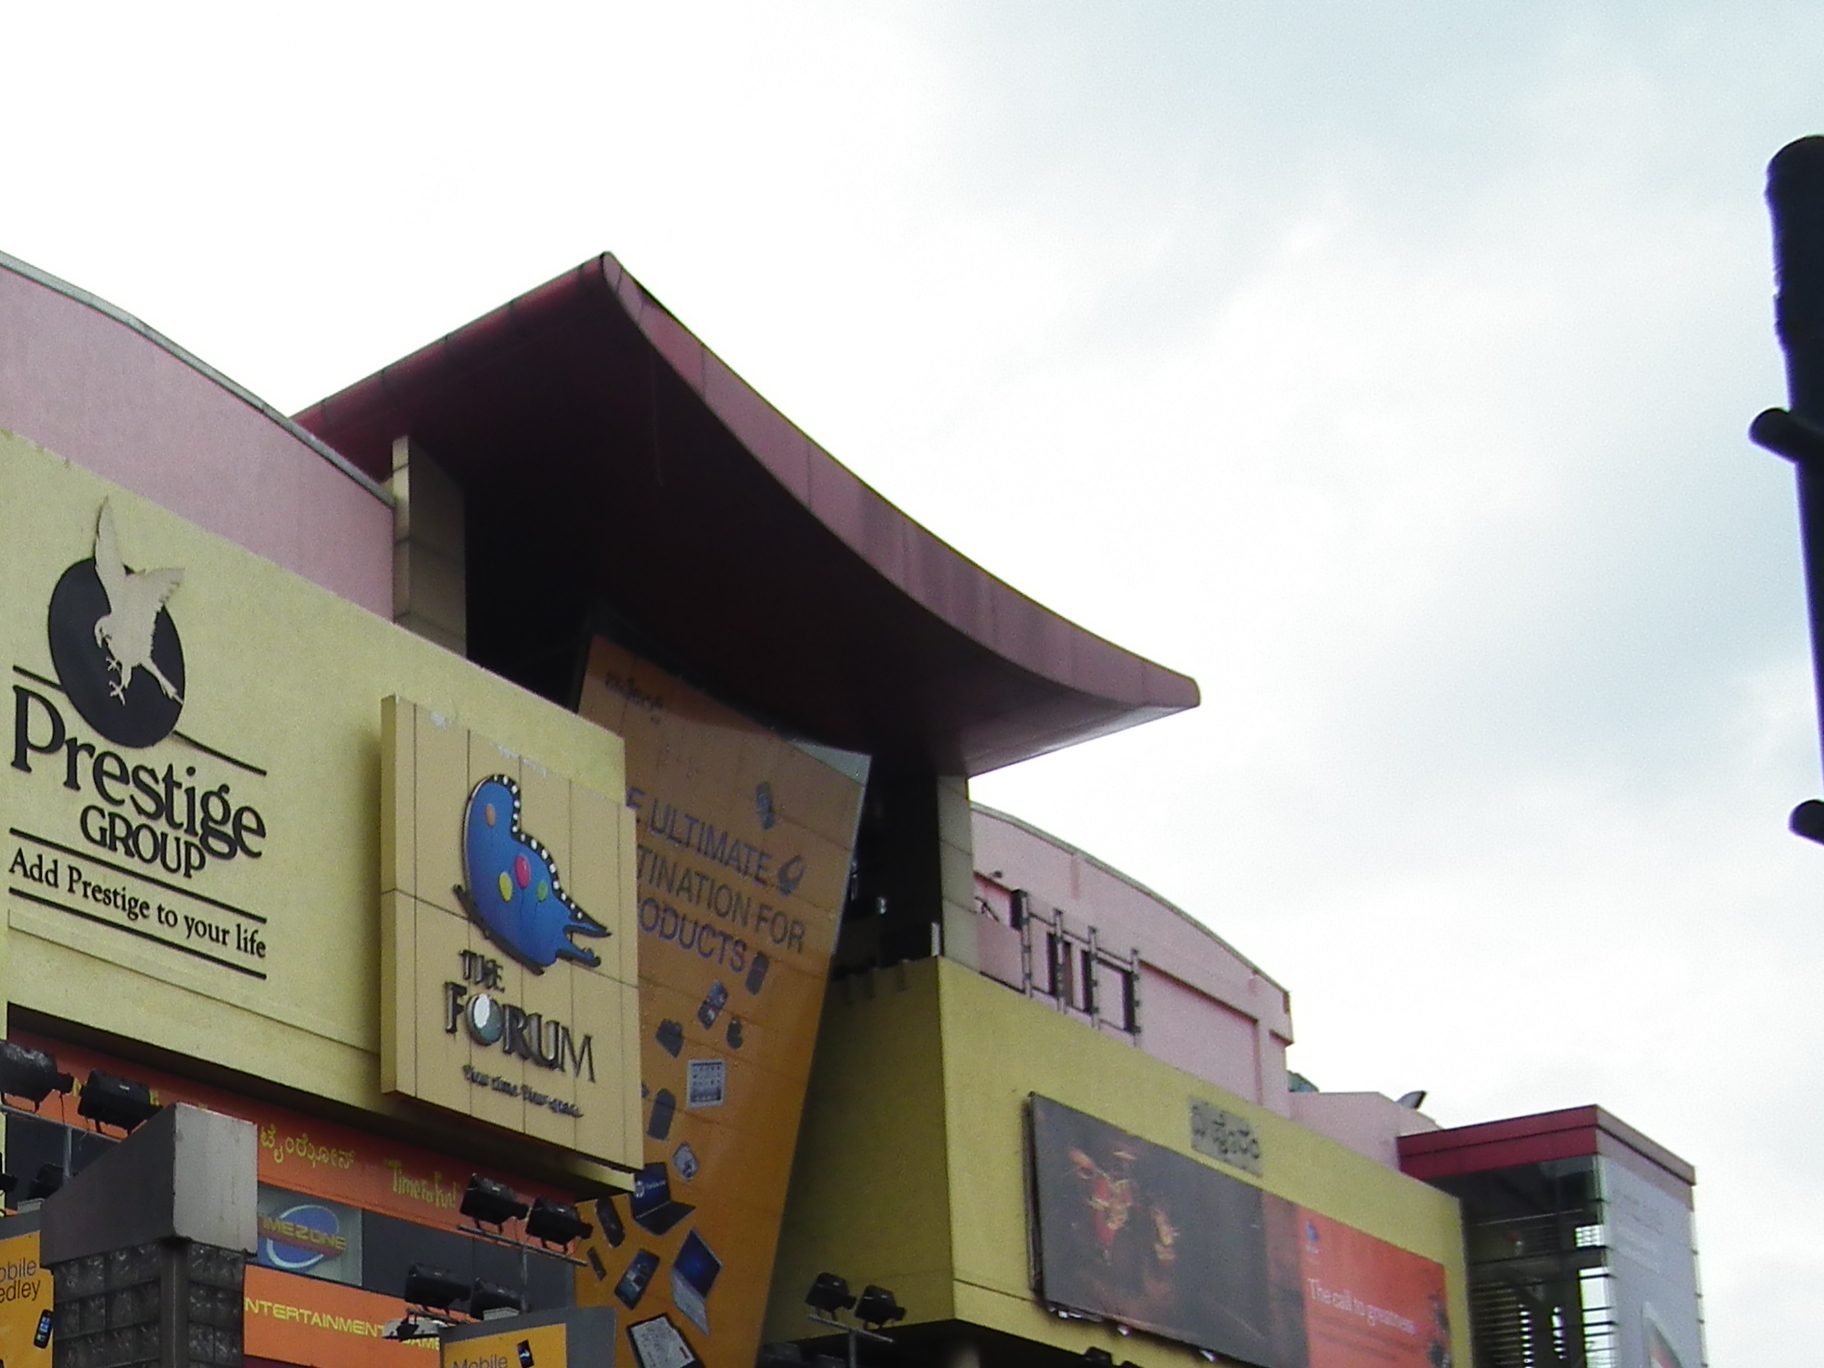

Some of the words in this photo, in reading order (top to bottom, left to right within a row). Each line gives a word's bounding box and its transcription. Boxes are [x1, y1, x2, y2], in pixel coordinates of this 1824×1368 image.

[10, 684, 267, 859] Prestige
[80, 804, 206, 879] GROUP
[647, 797, 773, 888] ULTIMATE
[9, 847, 59, 888] Add
[67, 864, 150, 921] Prestige
[157, 902, 177, 928] to
[183, 914, 230, 947] your
[235, 923, 267, 958] life
[636, 845, 752, 928] TINATION
[754, 903, 806, 954] FOR
[638, 896, 747, 974] ODUCTS
[444, 981, 596, 1083] FORUM
[258, 1213, 347, 1251] IMEZONE
[244, 1297, 384, 1338] NTERTAINMENT
